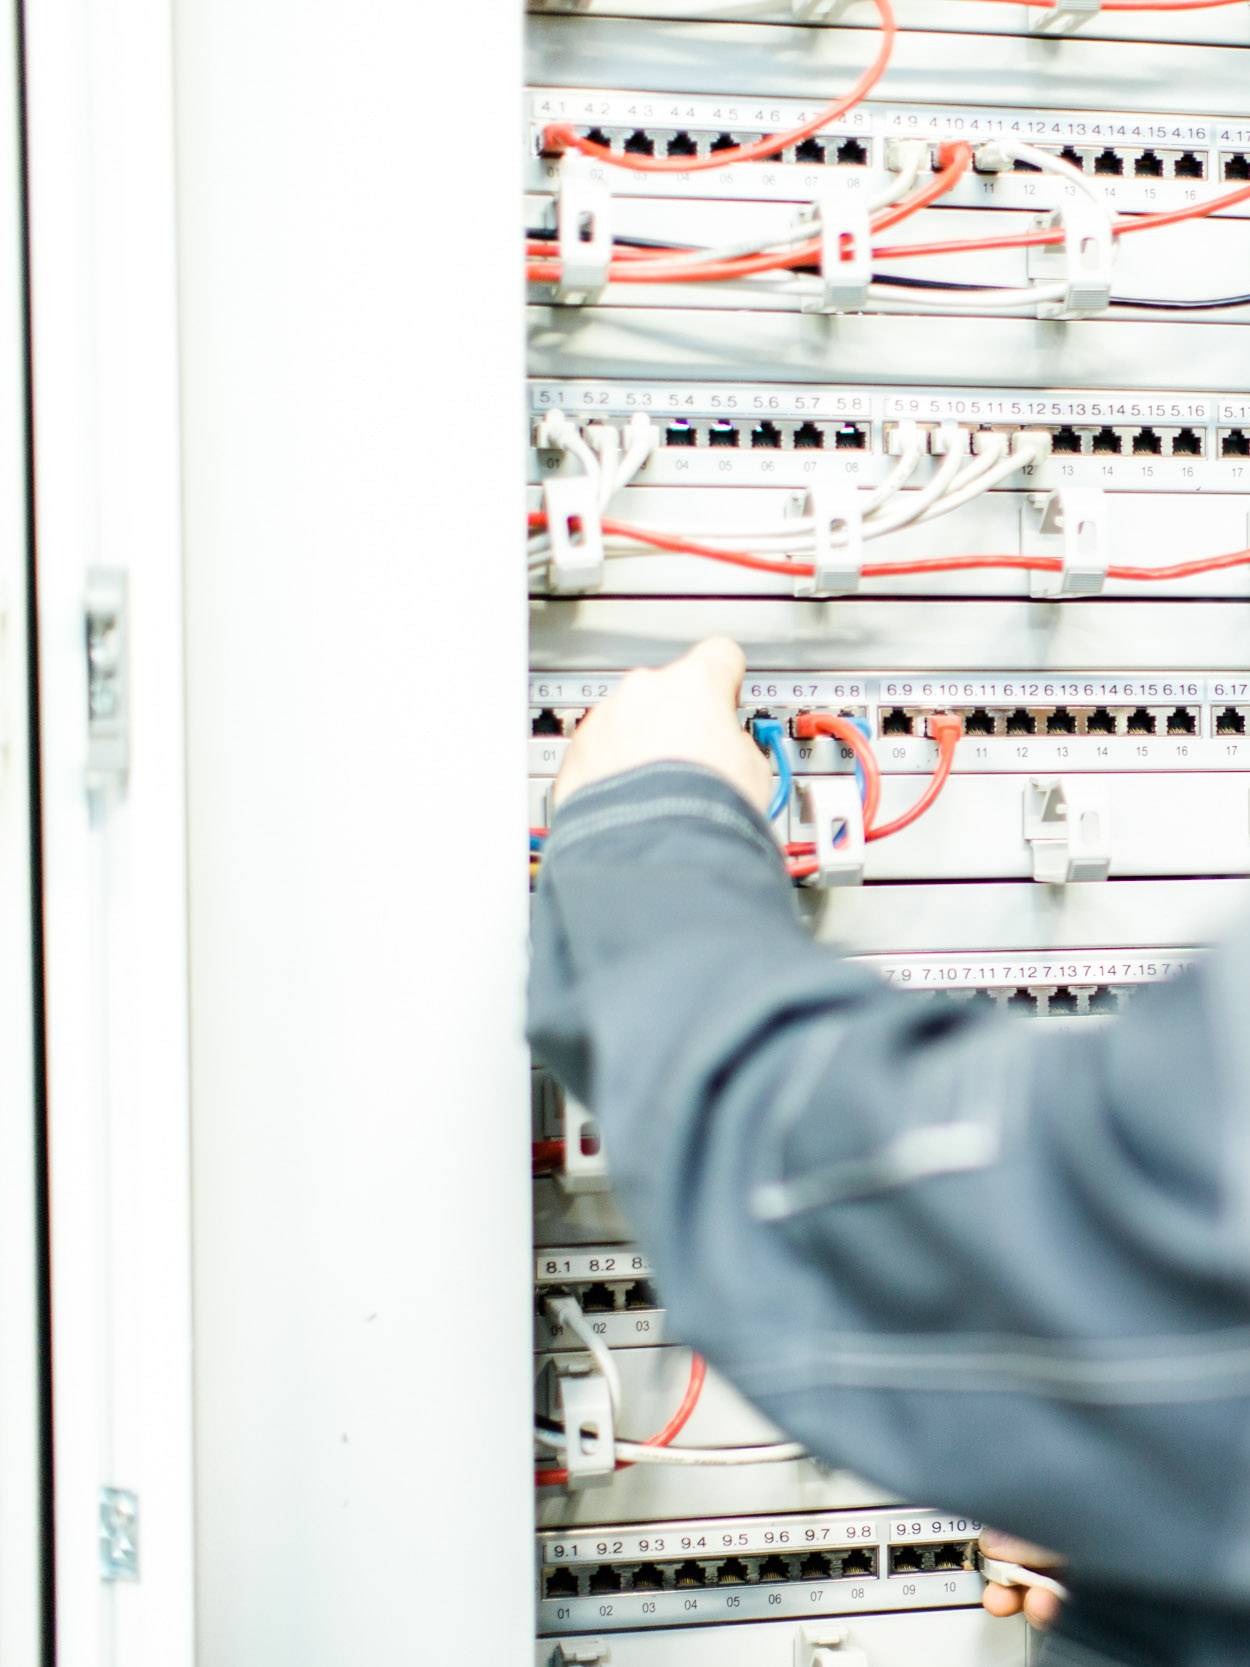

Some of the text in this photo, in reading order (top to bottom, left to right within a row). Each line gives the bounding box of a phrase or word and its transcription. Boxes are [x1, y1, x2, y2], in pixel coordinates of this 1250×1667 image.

[1011, 121, 1045, 133] 4.12
[1051, 123, 1086, 135] 4.13
[1092, 125, 1126, 136] 4.14
[1132, 126, 1166, 138] 4.15
[1172, 128, 1205, 139] 4.16
[720, 173, 733, 184] 05
[763, 175, 775, 185] 06
[805, 176, 818, 186] 07
[847, 178, 860, 188] 08
[984, 180, 1196, 200] 11 12 13 14 15 16
[540, 390, 862, 409] 5.1 5.2 5.3 5.4 5.5 5.6 5.7 5.8
[895, 400, 1204, 416] 5.9 5.10 5.11 5.12 5.13 5.14 5.15 5.16
[676, 459, 858, 472] 04 05 06 07 08
[1022, 464, 1193, 477] 12 13 14 15 16
[1232, 468, 1243, 477] 17
[538, 685, 859, 697] 6.1 6.2 6.6 6.7 6.8
[887, 684, 1197, 696] 6.9 6.10 6.11 6.12 6.13 6.14 6.15 6.16
[1215, 684, 1247, 695] 6.17
[543, 748, 854, 761] 01 07 08
[893, 746, 1188, 758] 09 11 12 13 14 15 16
[1227, 746, 1237, 755] 17
[886, 969, 912, 982] 7.9
[923, 968, 957, 980] 7.10
[963, 968, 994, 979] 7.11
[1003, 967, 1037, 978] 7.12
[1043, 966, 1077, 977] 7.13
[1083, 965, 1117, 976] 7.14
[1122, 964, 1156, 975] 7.15
[546, 1259, 615, 1274] 8.1 8.2
[593, 1323, 606, 1333] 02
[636, 1320, 649, 1331] 03
[897, 1523, 921, 1535] 9.9
[932, 1521, 966, 1533] 9.10
[554, 1526, 871, 1557] 9.1 9.2 9.3 9.4 9.5 9.6 9.7 9.8
[903, 1582, 956, 1595] 09 10
[557, 1588, 864, 1619] 01 02 03 04 05 06 07 08
